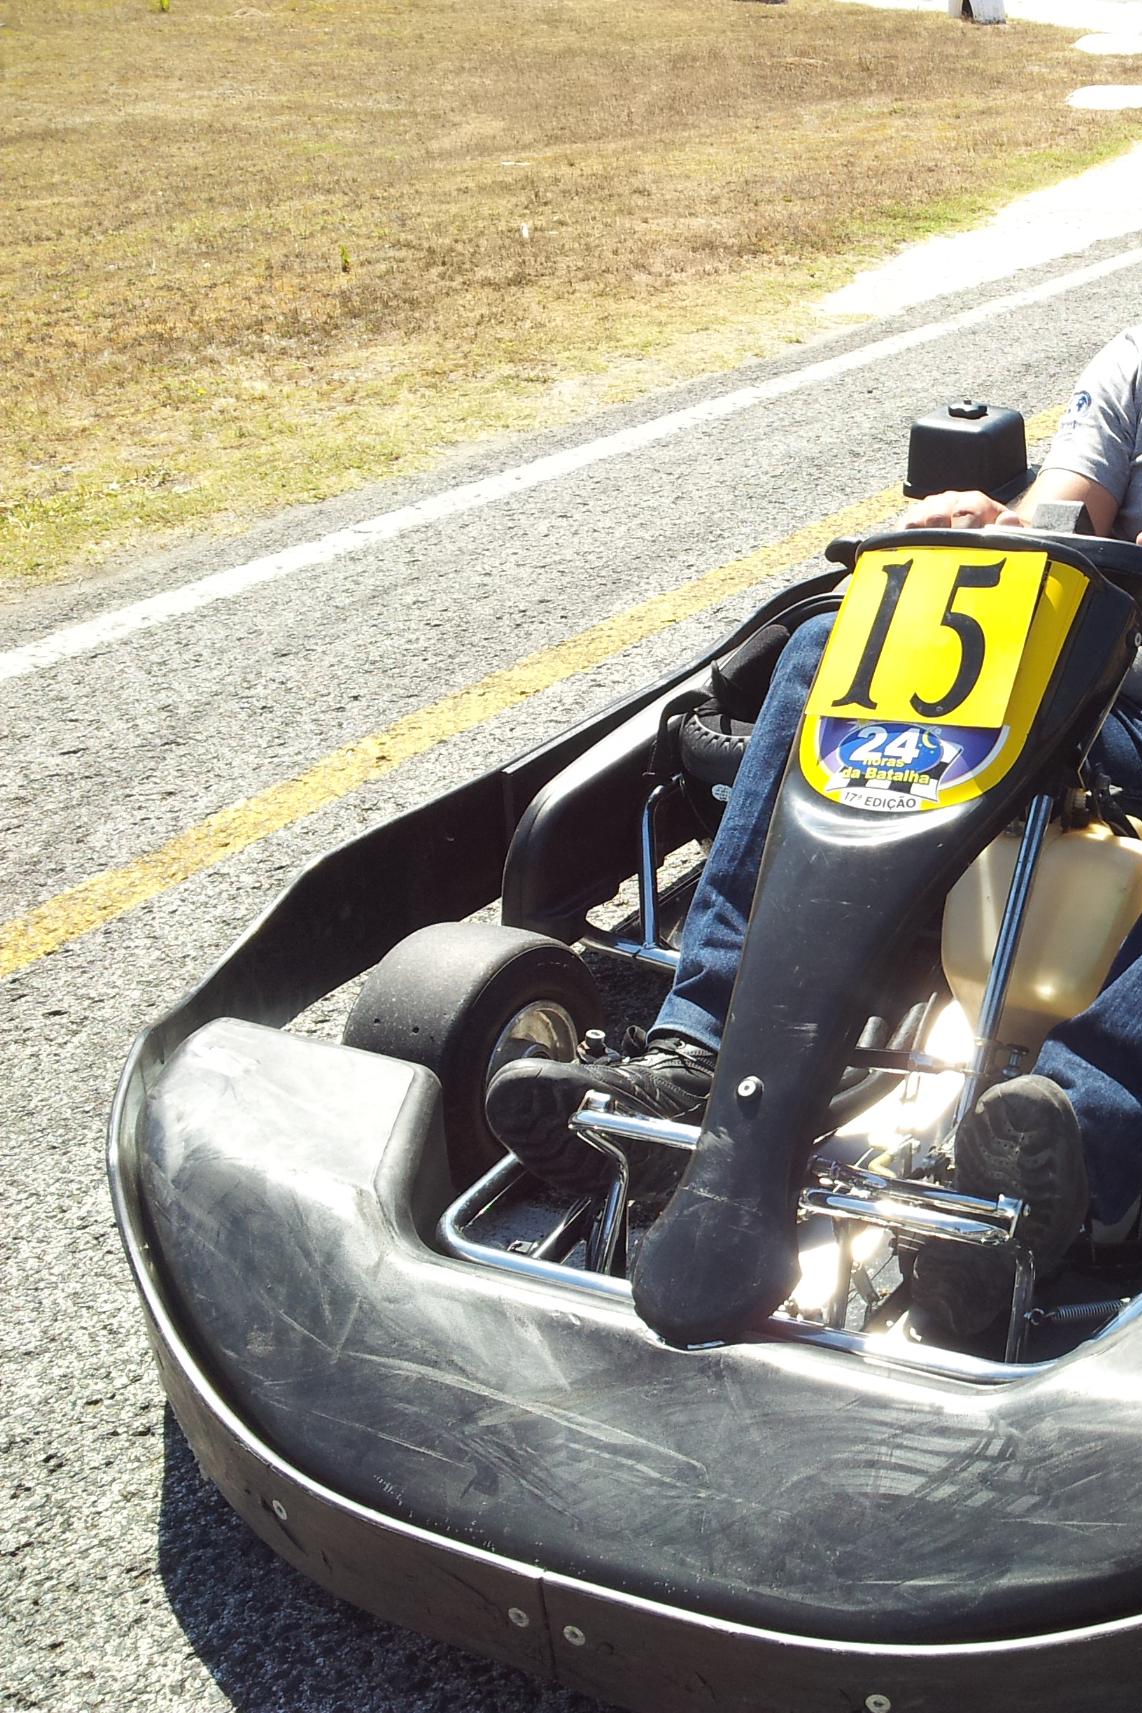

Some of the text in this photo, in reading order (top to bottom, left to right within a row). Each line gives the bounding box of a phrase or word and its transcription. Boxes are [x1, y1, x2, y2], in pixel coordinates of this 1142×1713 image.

[831, 556, 1008, 719] 15
[849, 725, 921, 764] 24
[841, 766, 931, 786] da Batalha
[864, 796, 917, 810] EDIÇÃO
